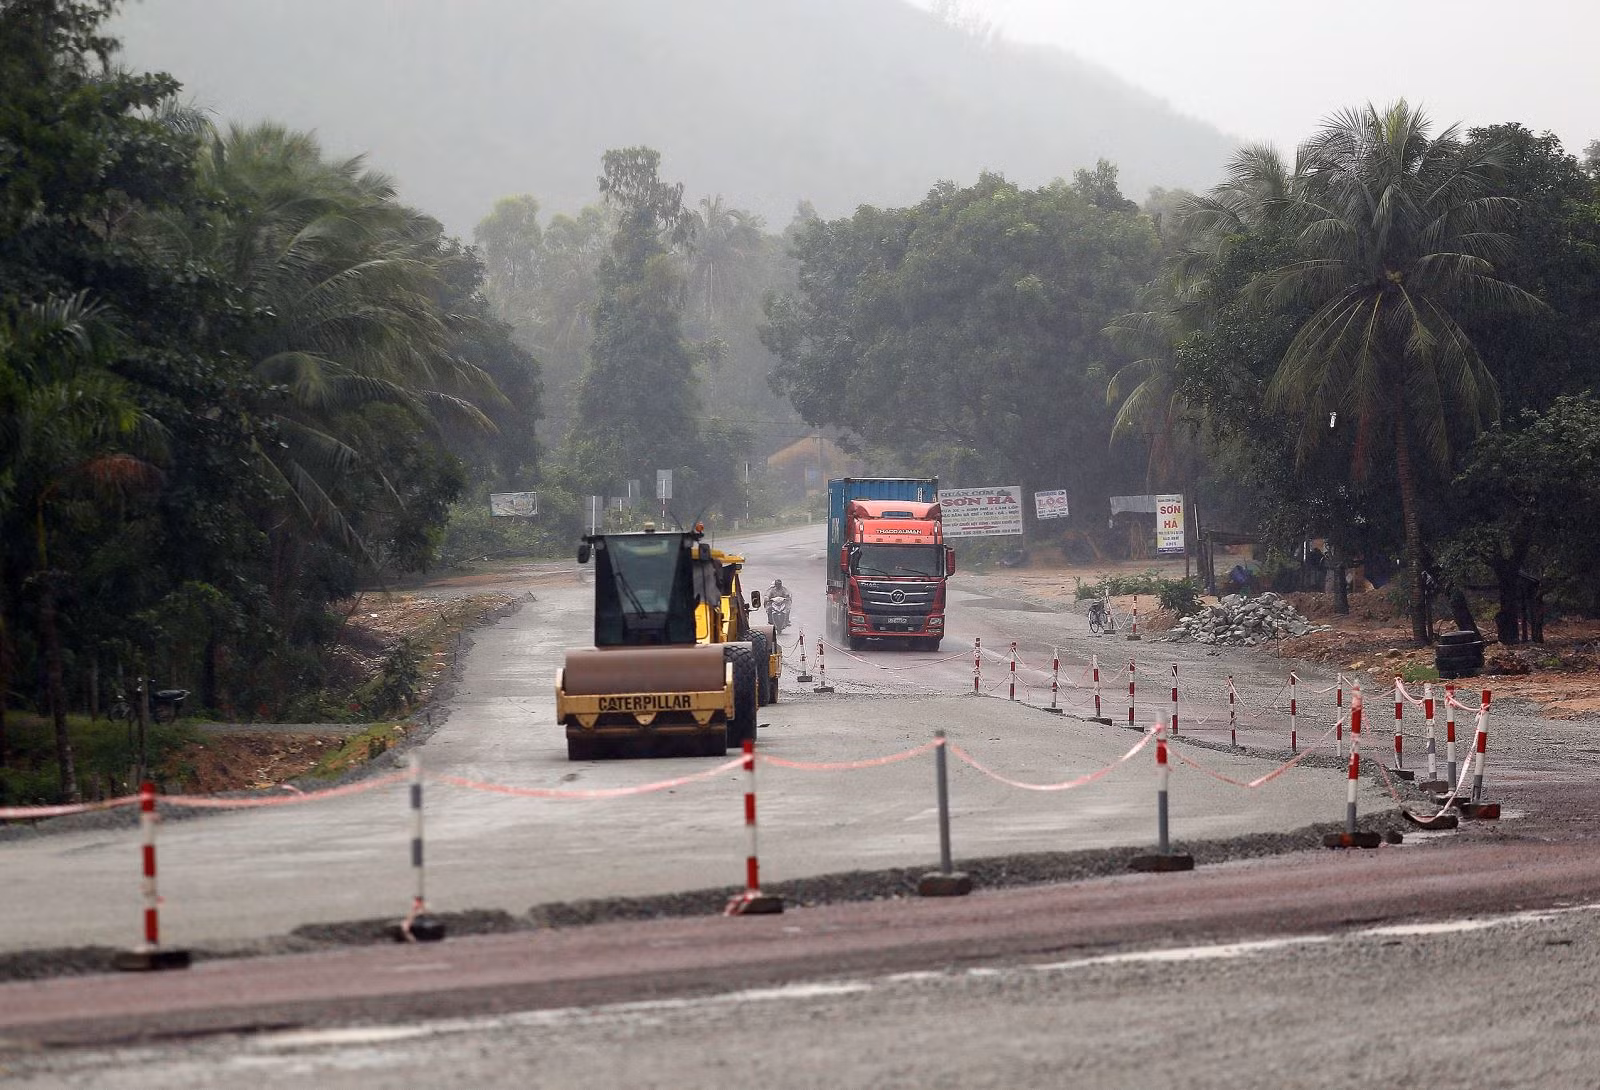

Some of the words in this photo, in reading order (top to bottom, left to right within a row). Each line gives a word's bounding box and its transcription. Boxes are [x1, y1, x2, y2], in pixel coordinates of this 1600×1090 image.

[941, 496, 982, 507] SƠN
[1160, 504, 1181, 514] SƠN
[598, 695, 691, 711] CATERPILLAR
